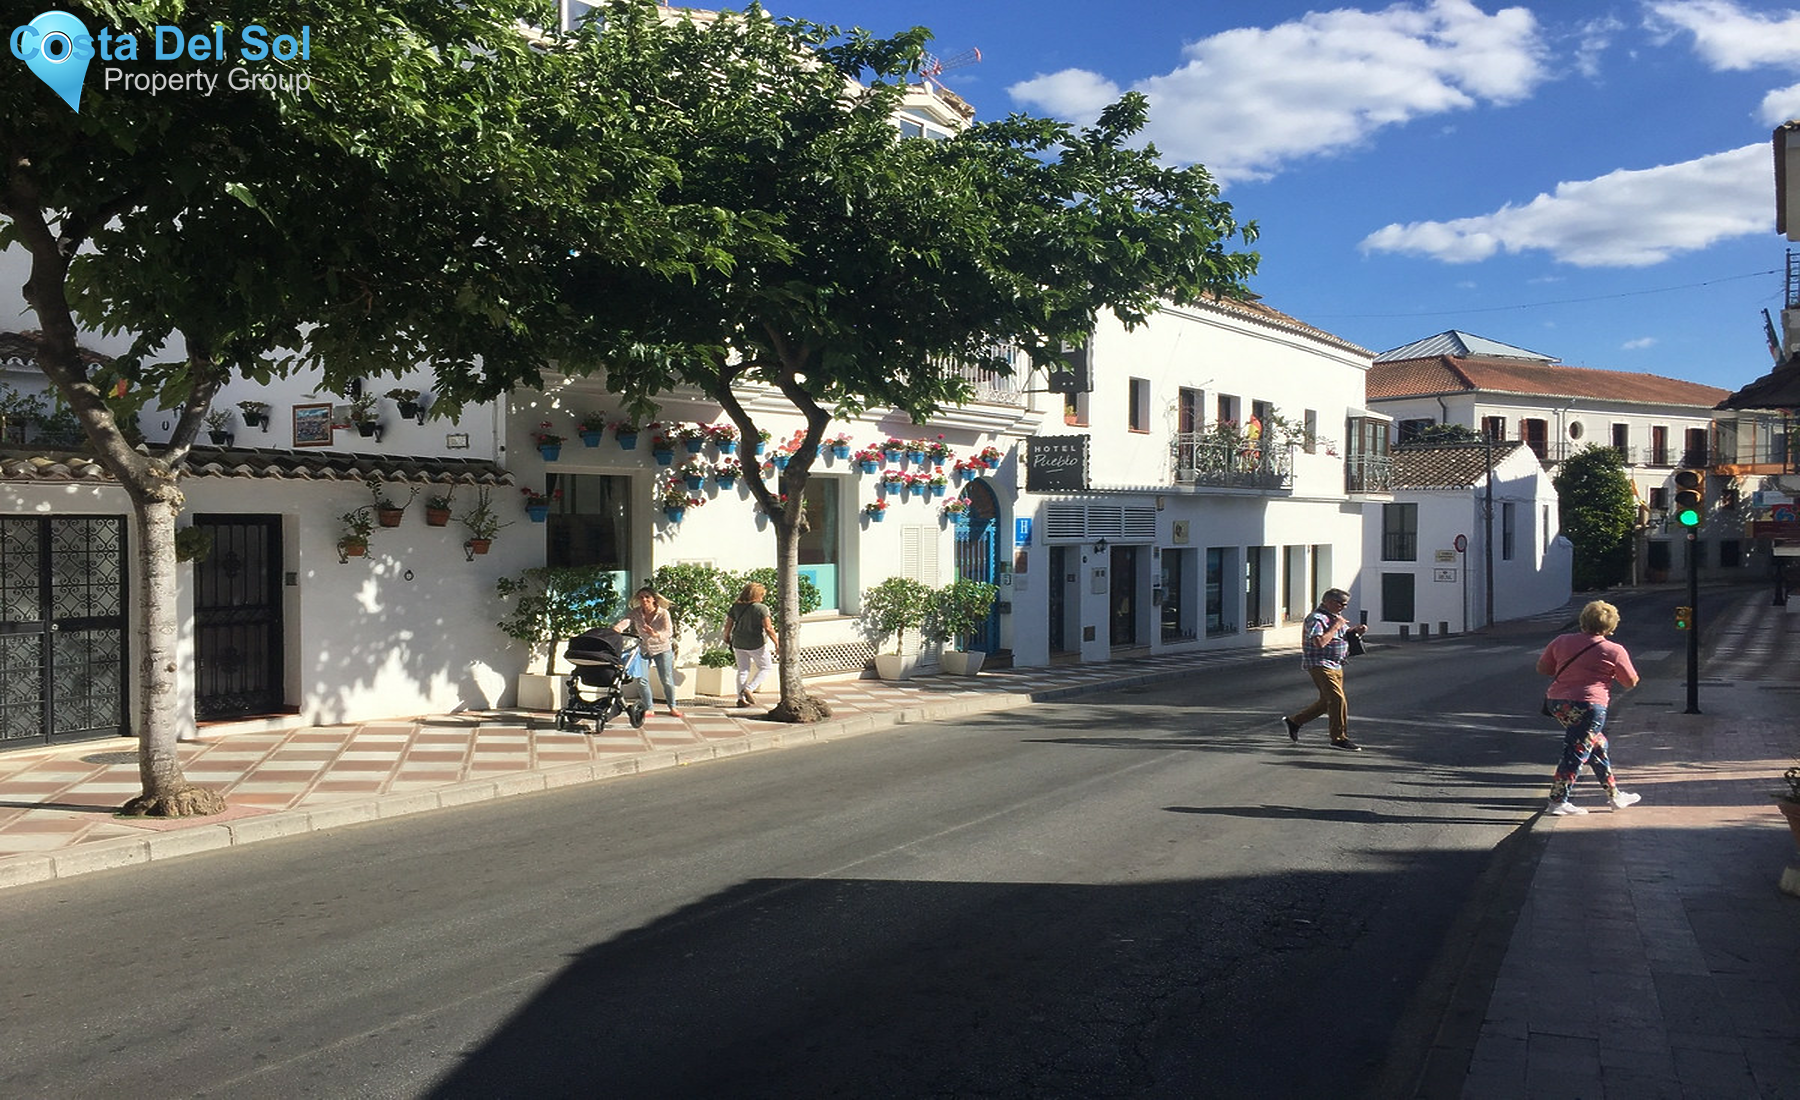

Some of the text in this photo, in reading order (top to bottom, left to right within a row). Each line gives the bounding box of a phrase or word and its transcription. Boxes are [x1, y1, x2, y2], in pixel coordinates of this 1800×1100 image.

[1034, 445, 1076, 453] HOTEL
[1033, 454, 1078, 468] Pueblo
[1020, 520, 1028, 534] H
